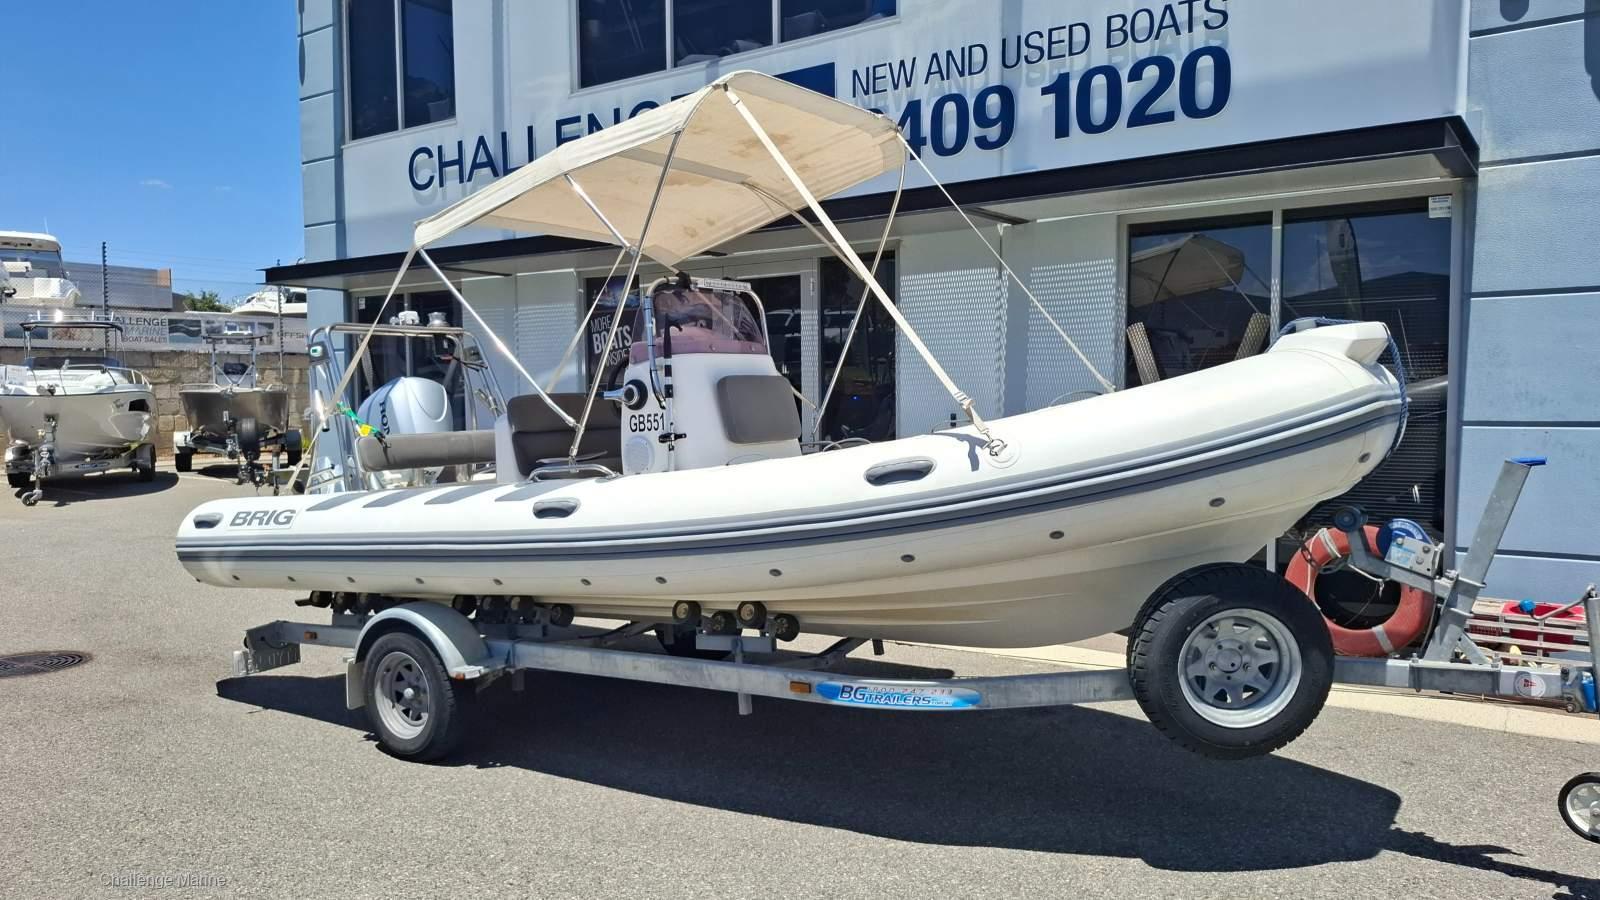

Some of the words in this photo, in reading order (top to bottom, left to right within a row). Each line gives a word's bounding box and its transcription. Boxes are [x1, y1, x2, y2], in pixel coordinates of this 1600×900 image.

[852, 57, 917, 98] NEW
[924, 43, 988, 84] AND
[1001, 22, 1091, 69] USED
[1106, 0, 1229, 49] BOATS
[866, 84, 1016, 161] 409
[1041, 45, 1232, 139] 1020
[408, 92, 697, 191] CHALLE
[590, 314, 611, 333] MORE
[592, 325, 632, 354] BOATS
[630, 412, 665, 432] GB551
[229, 509, 296, 526] BRIG
[840, 684, 867, 701] BG
[865, 692, 932, 705] TRAILERS
